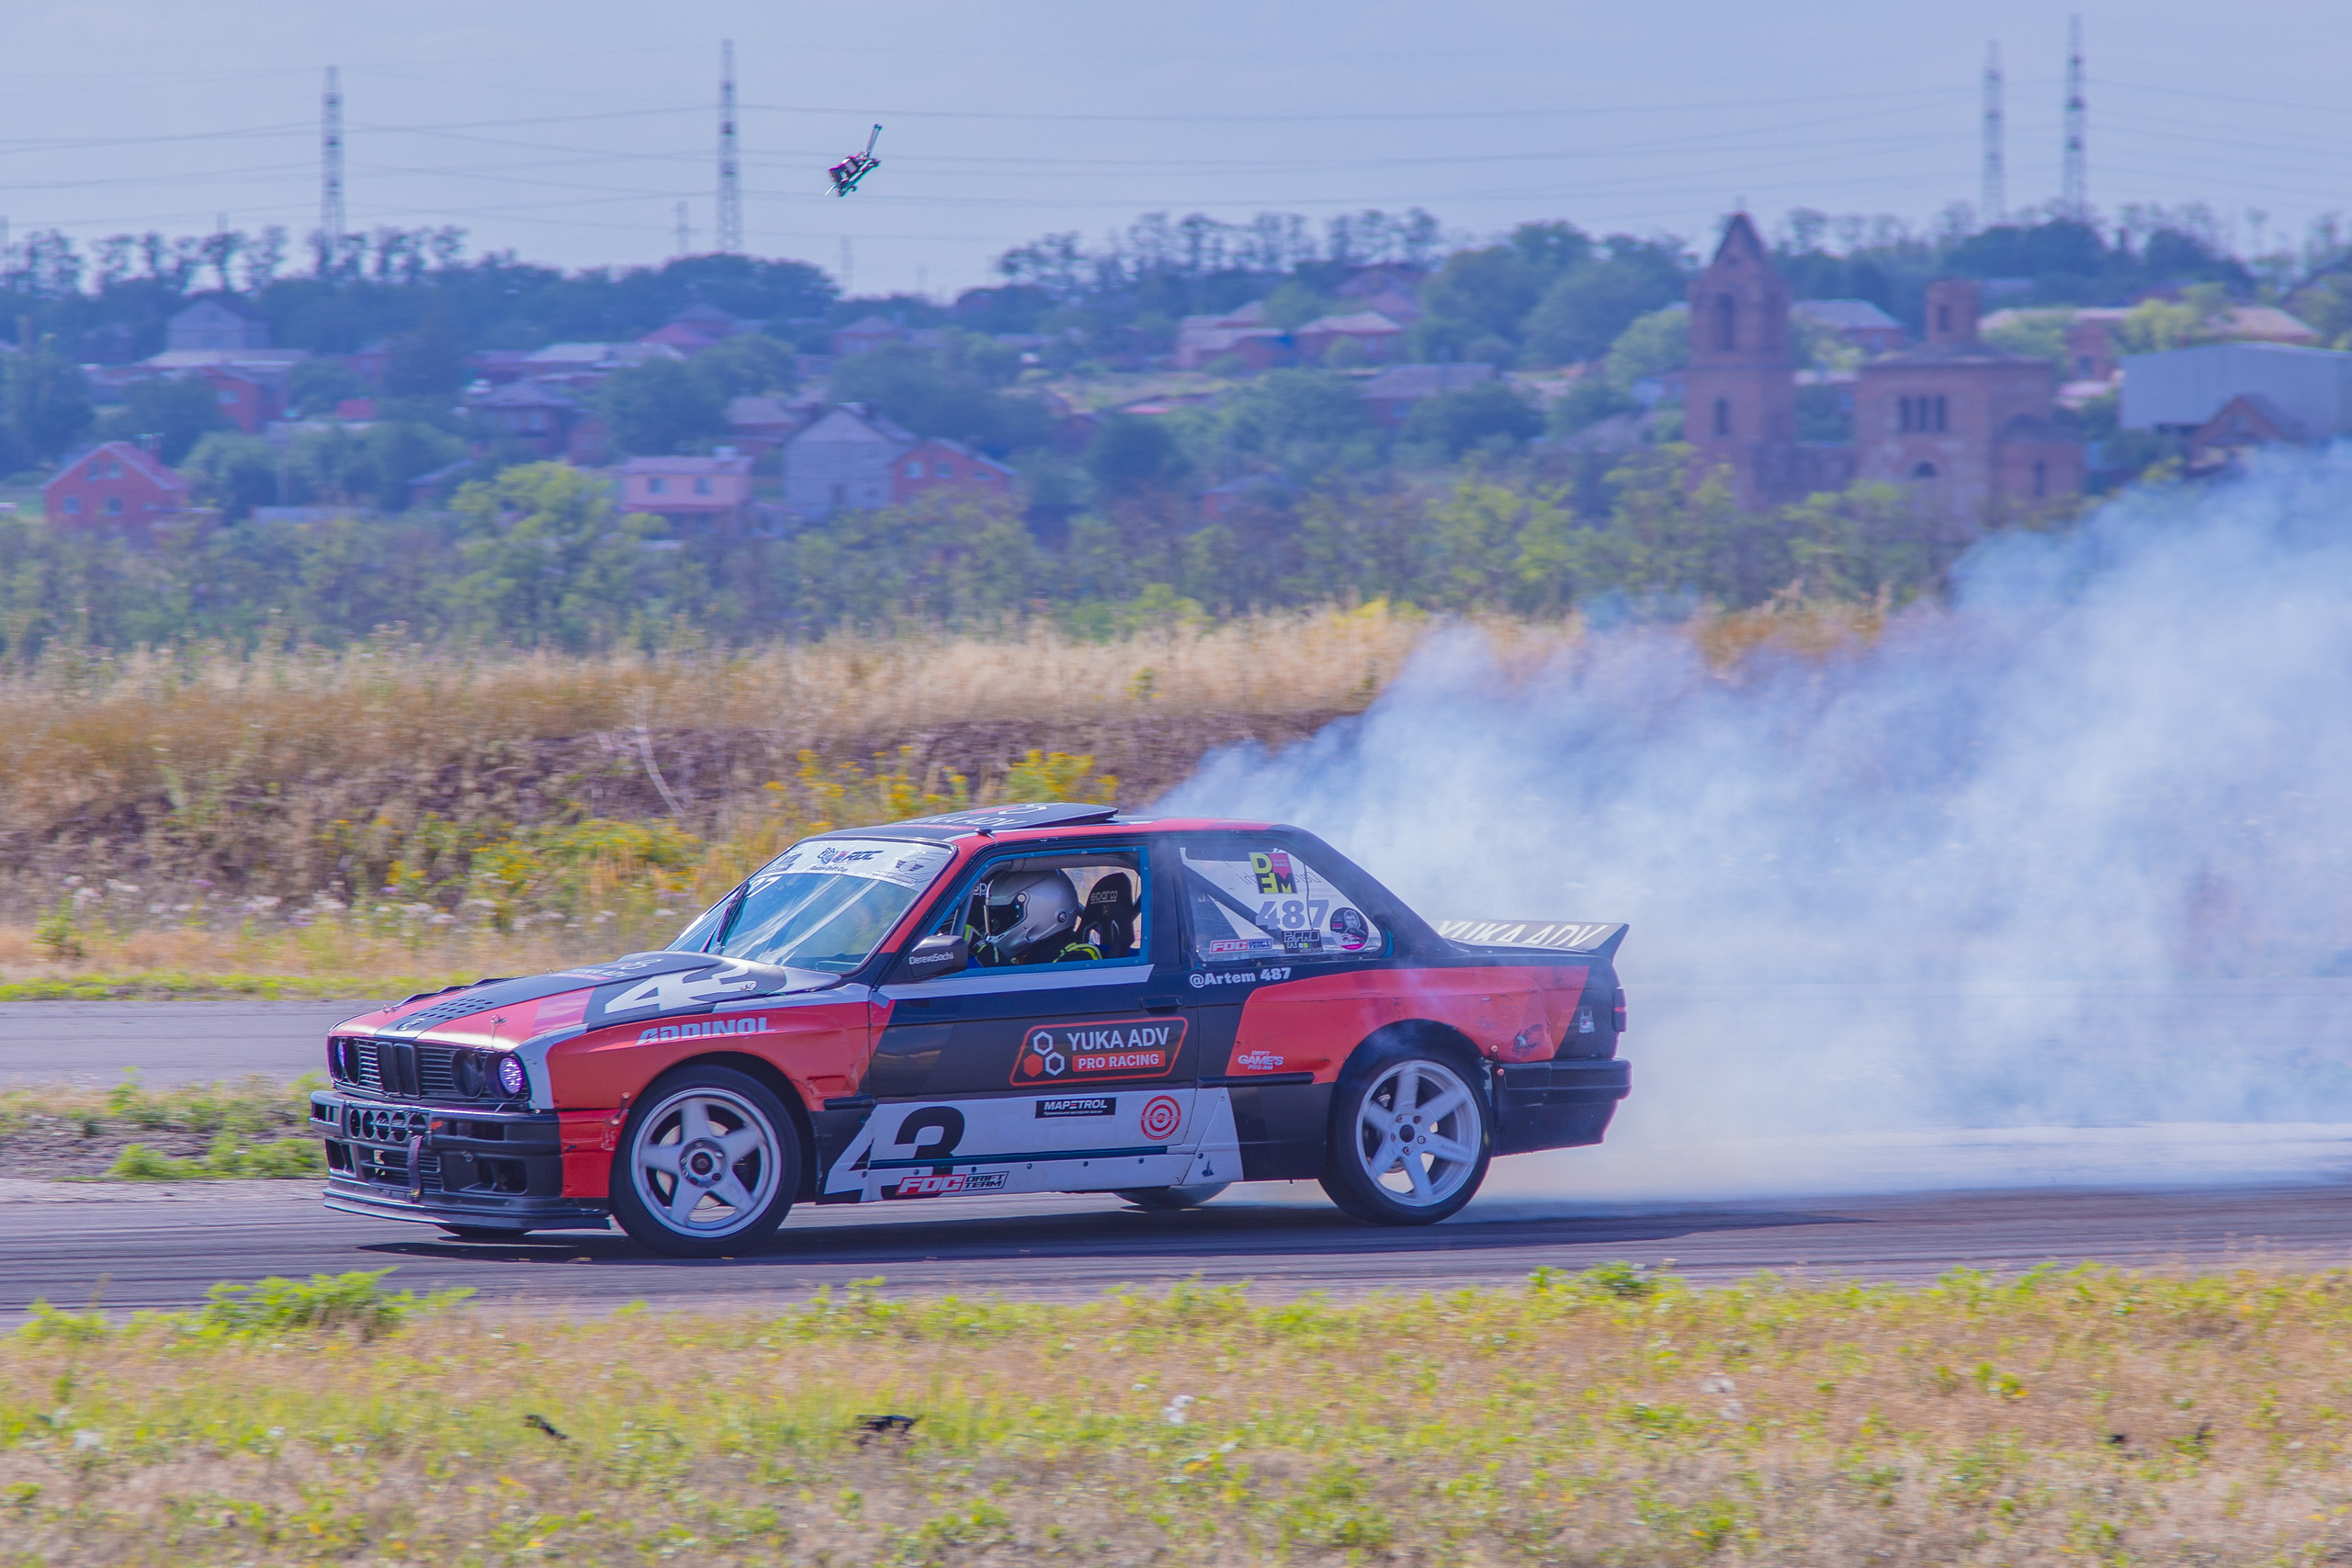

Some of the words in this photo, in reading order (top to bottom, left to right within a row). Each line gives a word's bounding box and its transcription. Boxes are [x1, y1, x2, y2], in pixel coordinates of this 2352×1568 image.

[1255, 899, 1329, 931] 487
[1521, 924, 1609, 948] ADV
[1189, 973, 1256, 988] @Artem
[1260, 967, 1292, 981] 487
[635, 1017, 777, 1046] ADDINOL
[1066, 1030, 1125, 1052] YUKA
[1127, 1027, 1170, 1048] ADV
[1078, 1057, 1105, 1070] PRO
[1109, 1054, 1159, 1068] RACING
[1044, 1100, 1108, 1111] MAPETROL
[899, 1176, 965, 1194] FDC
[964, 1180, 1003, 1189] TEAM
[966, 1174, 1007, 1182] DRIFT
